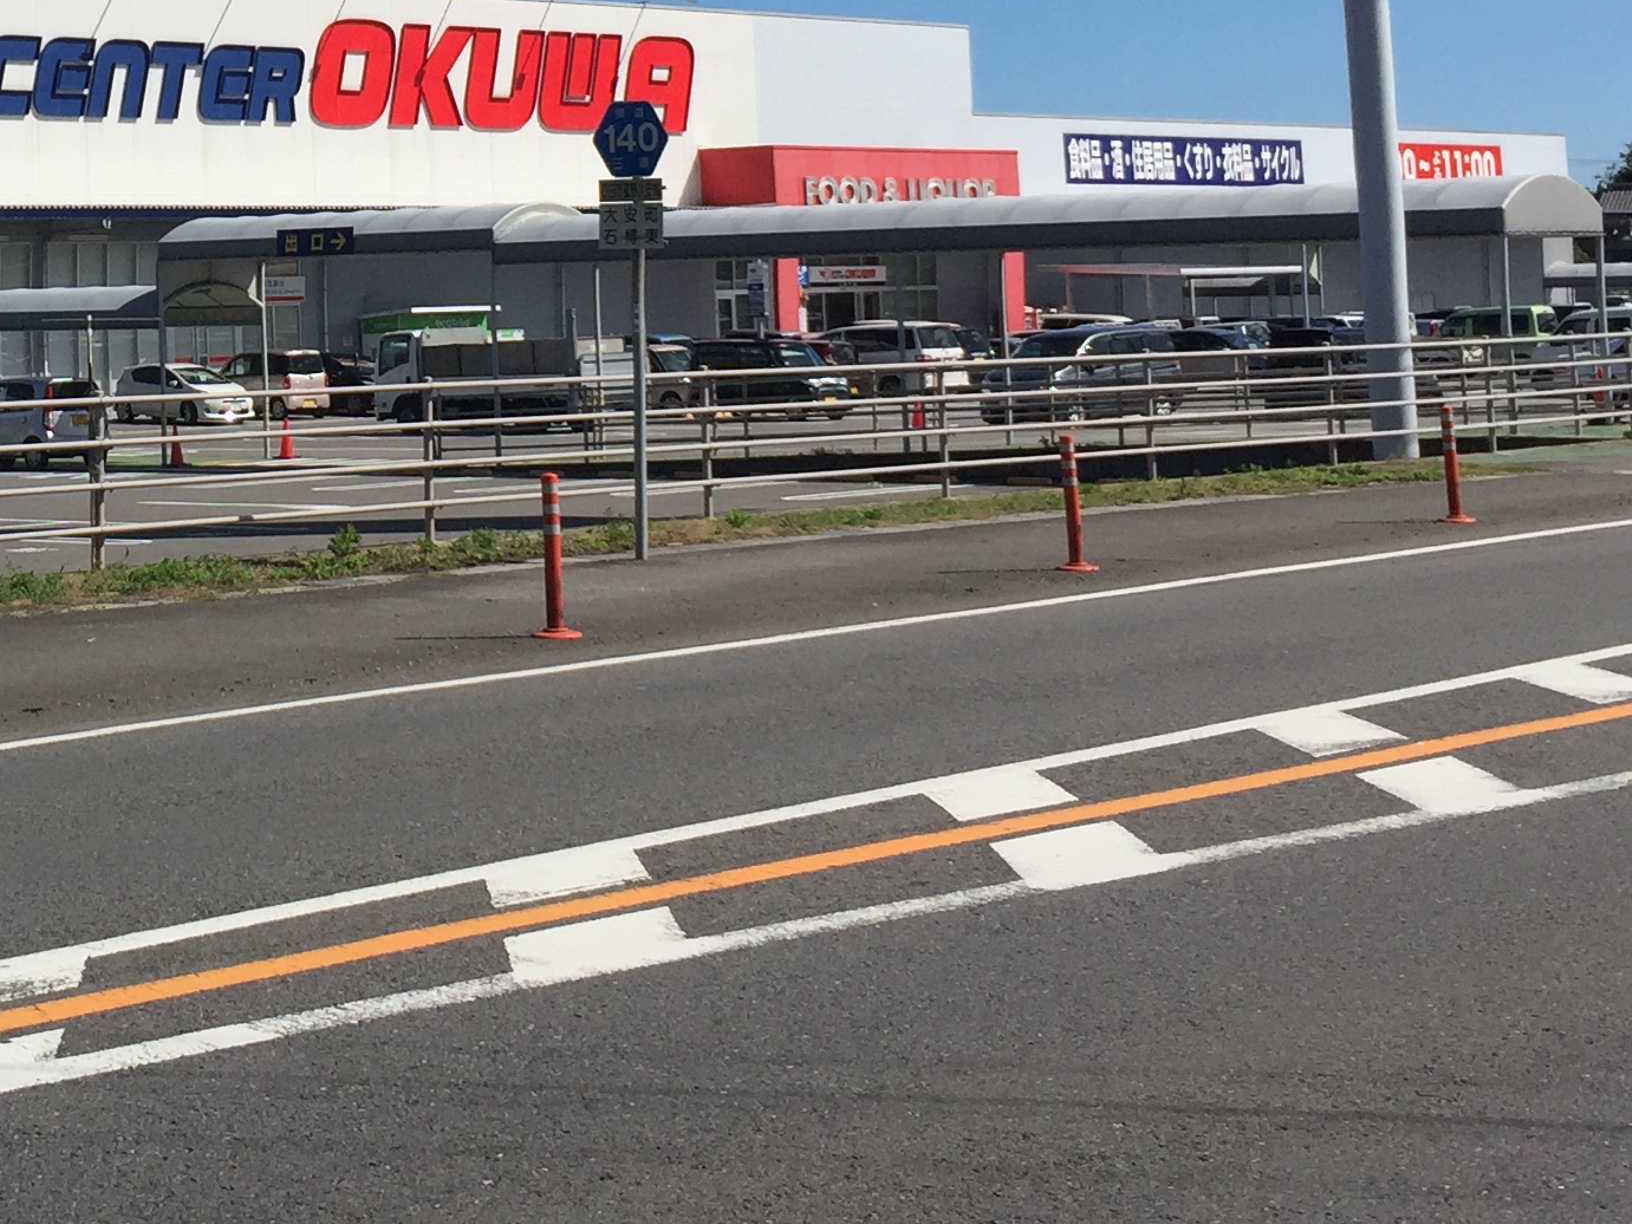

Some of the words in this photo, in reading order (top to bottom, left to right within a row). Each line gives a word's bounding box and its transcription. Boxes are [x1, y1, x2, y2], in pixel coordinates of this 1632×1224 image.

[309, 19, 695, 134] OKUWA
[604, 122, 658, 155] 140
[1442, 150, 1496, 178] 11:00
[804, 176, 877, 205] FOOD
[285, 233, 325, 253] 出口
